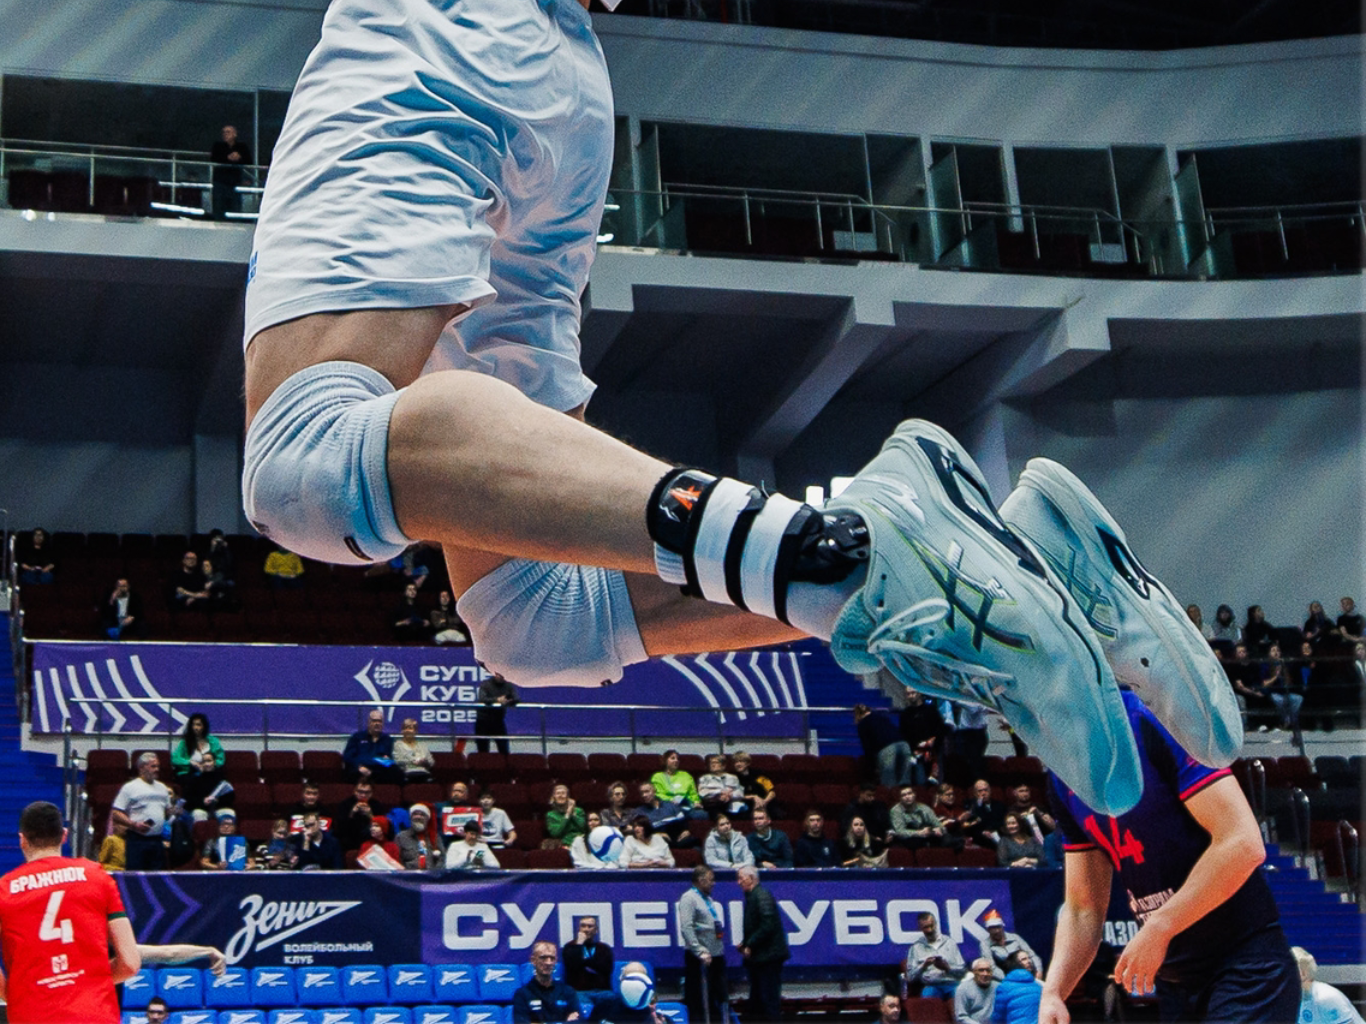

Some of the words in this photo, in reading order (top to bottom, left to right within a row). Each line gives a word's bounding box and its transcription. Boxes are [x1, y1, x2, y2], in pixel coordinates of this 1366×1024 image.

[1084, 814, 1145, 871] 14
[9, 866, 87, 894] БРАЖНЮК
[39, 890, 75, 944] 4
[284, 956, 314, 964] КЛУБ
